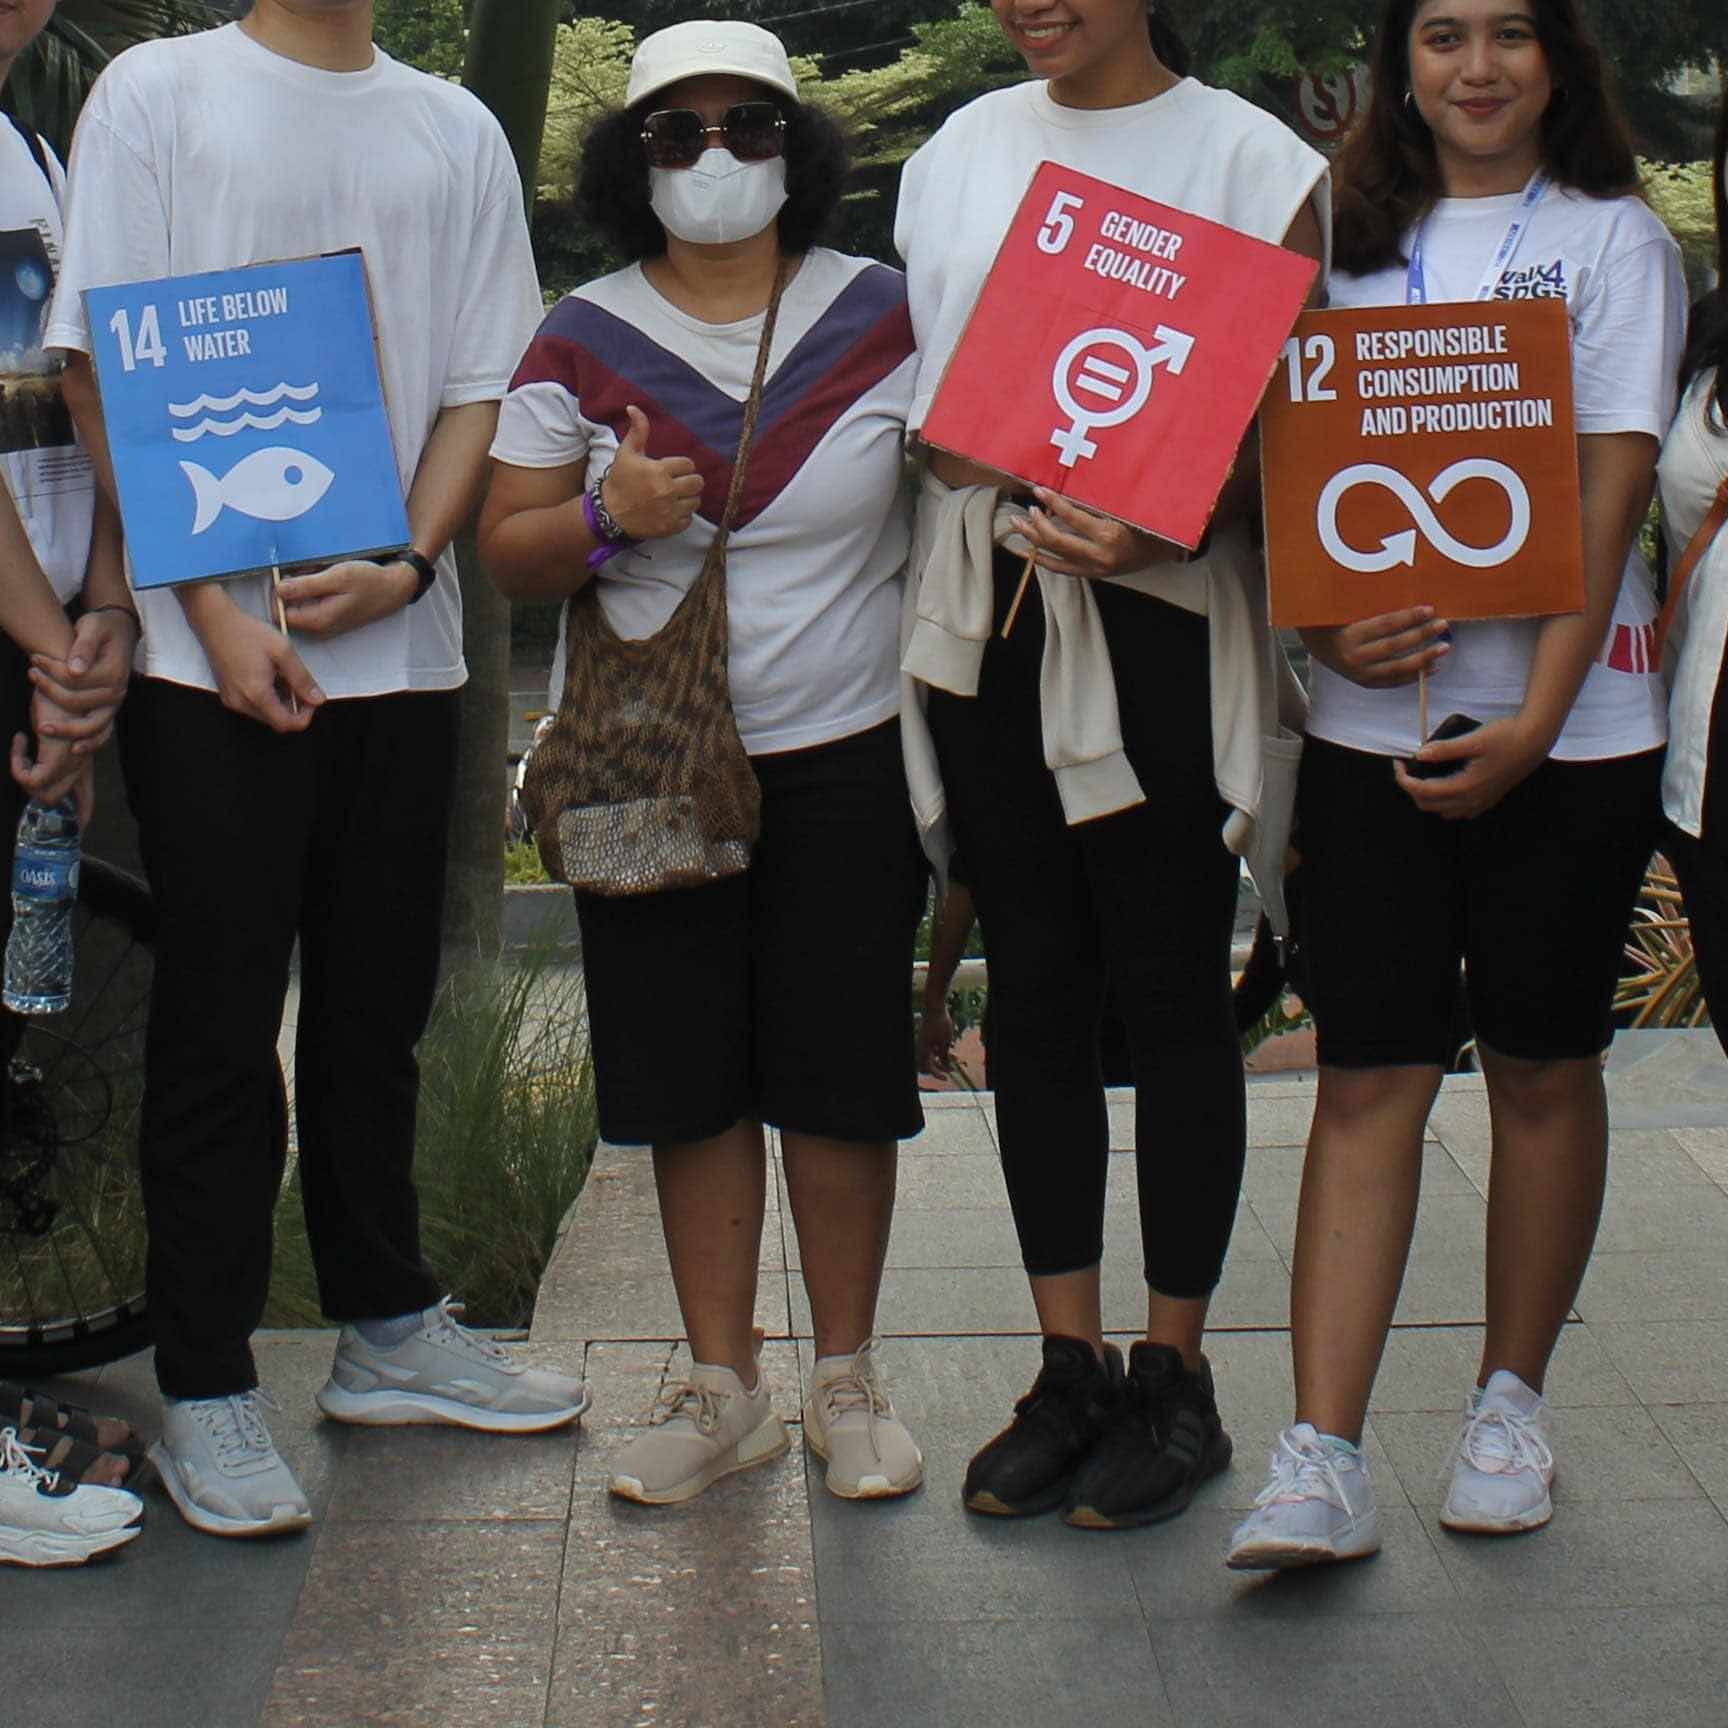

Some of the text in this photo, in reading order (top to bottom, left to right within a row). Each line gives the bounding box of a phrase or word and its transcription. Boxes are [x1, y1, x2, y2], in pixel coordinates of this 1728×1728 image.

[1036, 191, 1084, 255] 5
[1100, 211, 1183, 262] GENDER
[1083, 244, 1187, 301] EQUALITY
[178, 287, 288, 328] LIFE BELOW
[110, 304, 168, 372] 14
[184, 330, 251, 362] WATER
[1355, 324, 1508, 361] RESPONSIBLE
[1280, 334, 1337, 403] 12
[1358, 362, 1520, 399] CONSUMPTION
[1361, 398, 1553, 436] AND PRODUCTION
